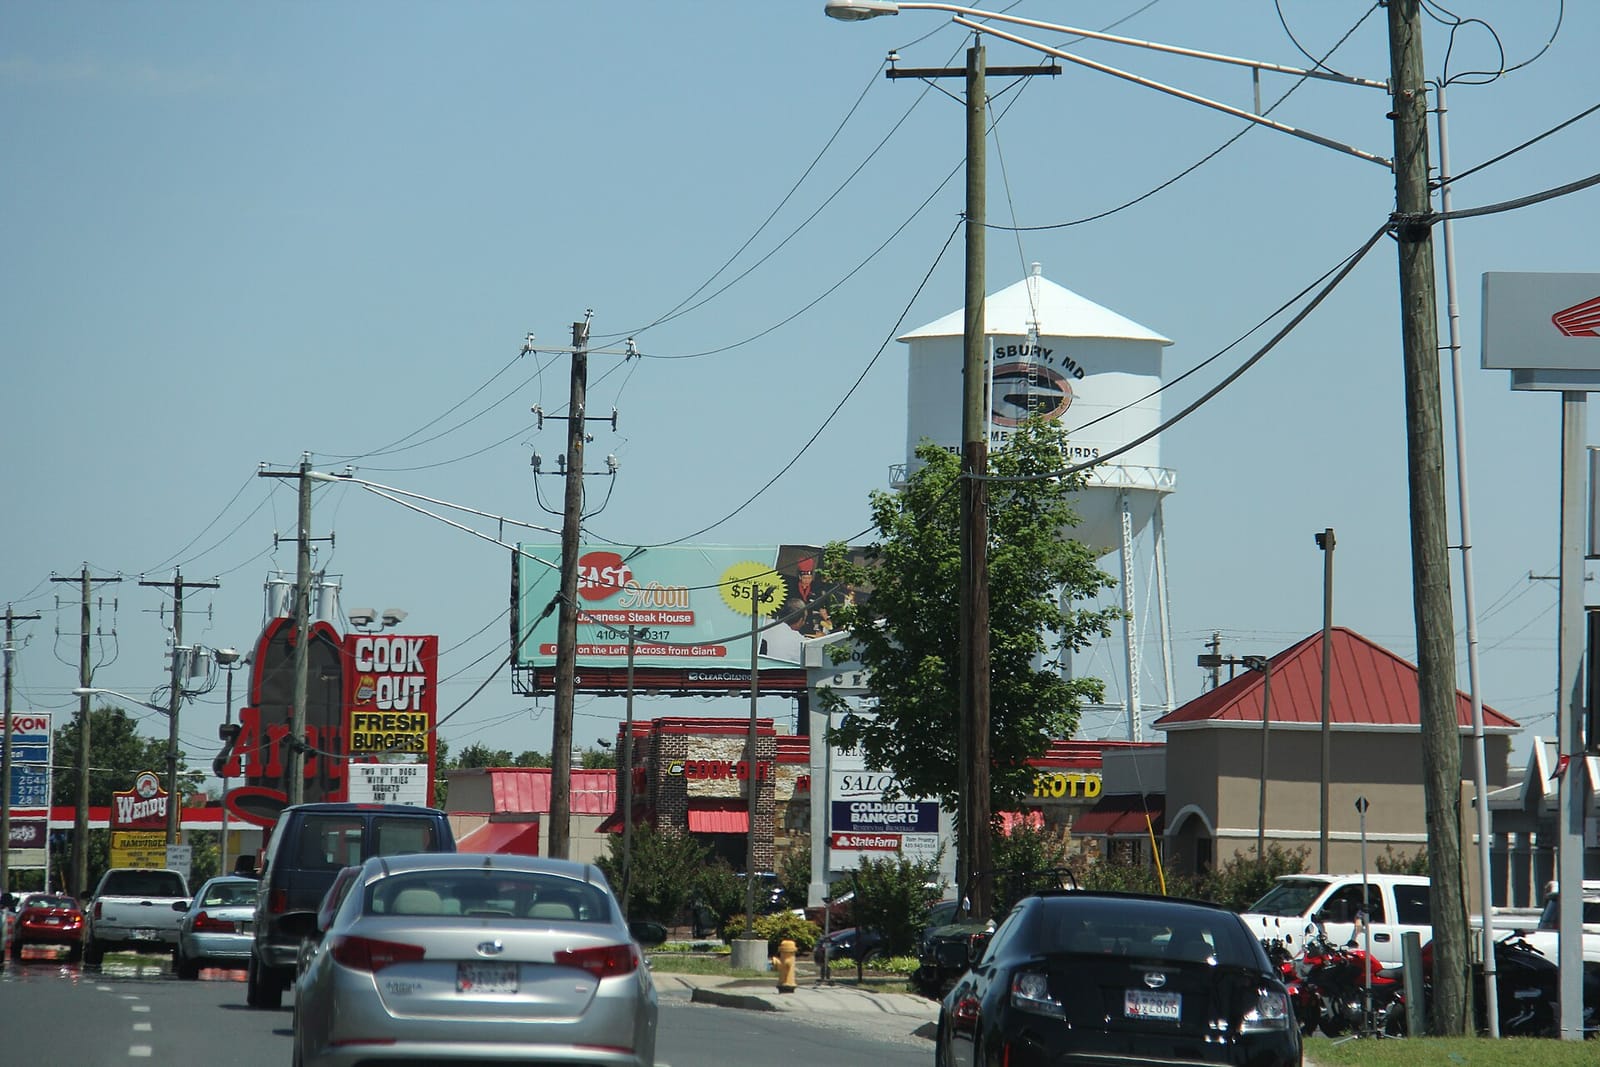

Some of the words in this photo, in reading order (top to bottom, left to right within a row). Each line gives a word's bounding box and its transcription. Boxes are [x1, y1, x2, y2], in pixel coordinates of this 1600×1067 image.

[1061, 356, 1085, 380] MD
[577, 565, 631, 588] EAST
[577, 612, 625, 624] Japanese
[628, 612, 656, 623] Steak
[658, 613, 691, 623] House
[355, 638, 425, 673] COOK
[592, 646, 606, 654] the
[608, 646, 626, 655] Left
[635, 646, 665, 655] Across
[668, 646, 689, 655] from
[691, 646, 716, 656] Giant
[376, 676, 426, 710] OUT
[353, 714, 426, 731] FRESH
[353, 732, 425, 750] BURGERS
[390, 776, 408, 784] FRIES
[850, 802, 919, 813] COLDWELL
[850, 813, 906, 824] BANKER
